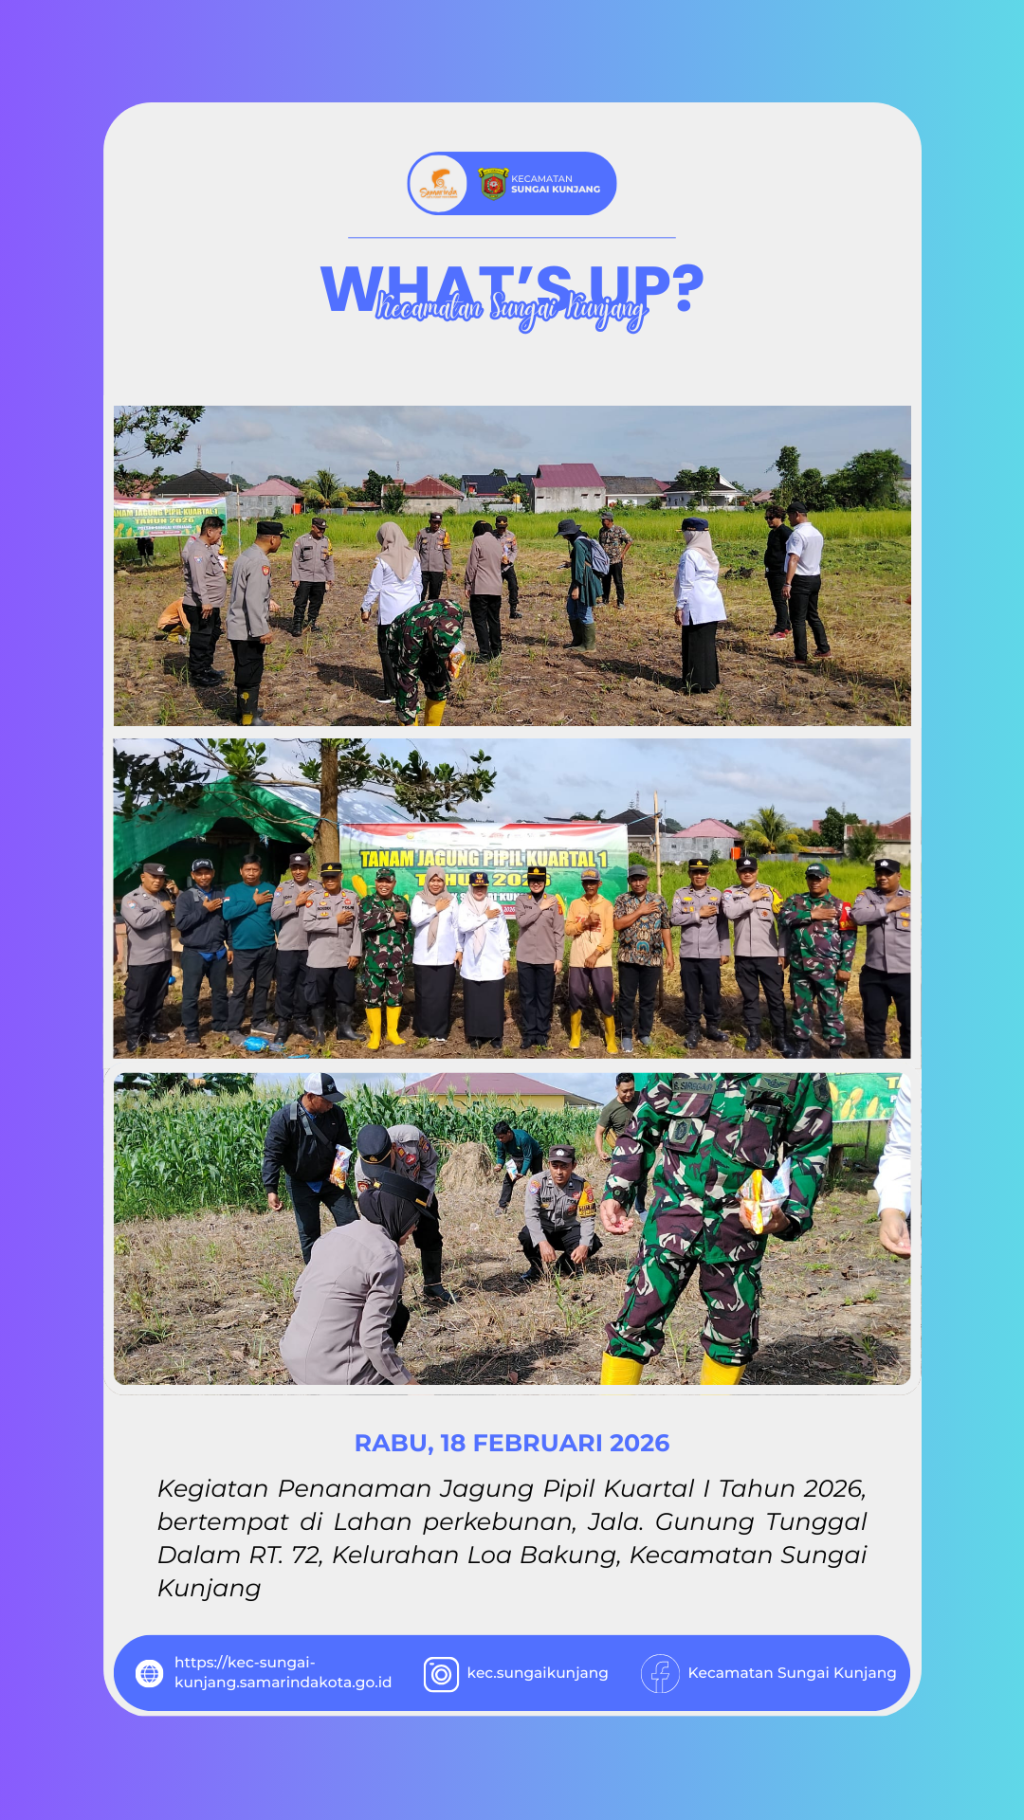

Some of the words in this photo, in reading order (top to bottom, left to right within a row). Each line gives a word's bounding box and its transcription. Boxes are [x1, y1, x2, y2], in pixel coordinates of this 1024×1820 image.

[359, 849, 415, 868] TANAM
[417, 849, 480, 867] JAGUNG
[483, 849, 523, 867] PIPIL
[526, 849, 597, 868] KUARTAL
[598, 850, 608, 869] 1
